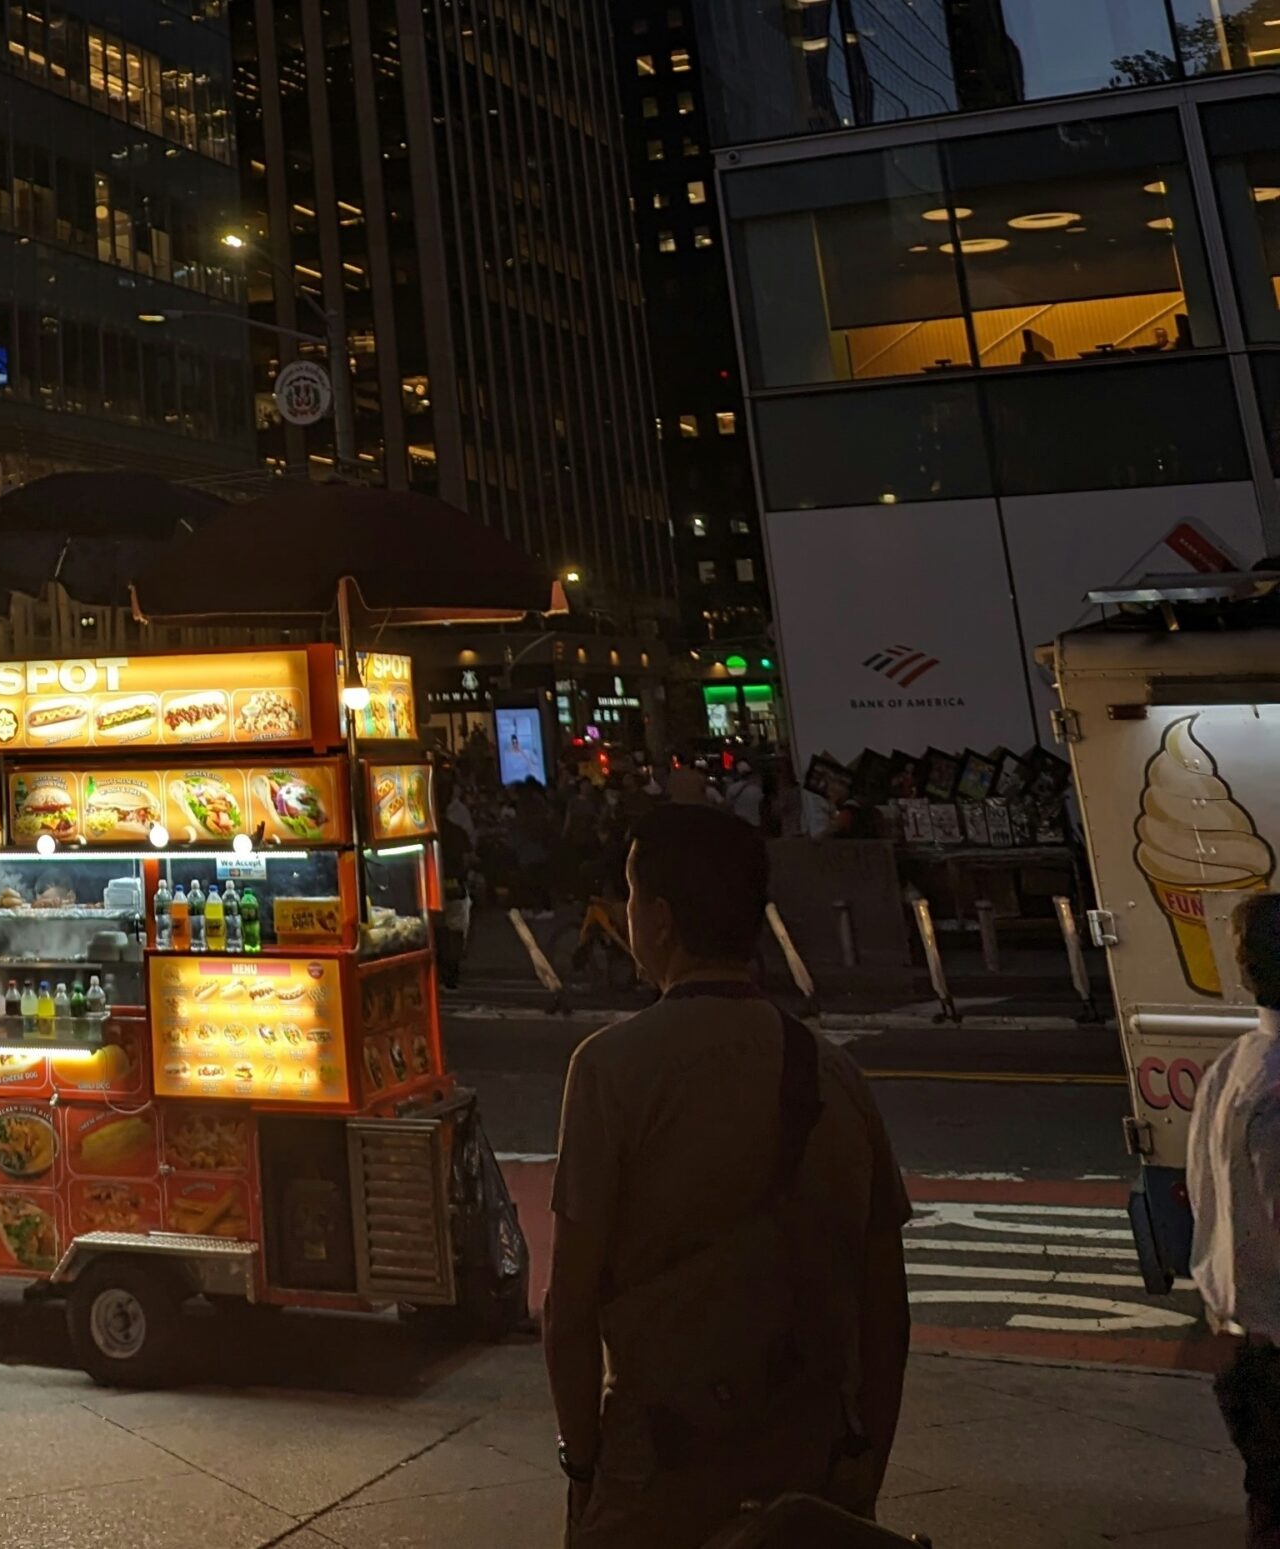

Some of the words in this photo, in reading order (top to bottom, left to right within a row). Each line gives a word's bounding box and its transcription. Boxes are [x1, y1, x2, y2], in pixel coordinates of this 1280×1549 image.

[372, 654, 410, 680] SPOT
[850, 699, 885, 709] BANK
[888, 699, 902, 708] OF
[906, 697, 965, 708] AMERICA
[221, 859, 233, 867] We
[235, 859, 262, 868] Accept
[1165, 891, 1205, 917] FUN
[232, 963, 258, 975] MENU
[2, 1074, 22, 1085] CHEESE
[23, 1071, 38, 1082] DOG
